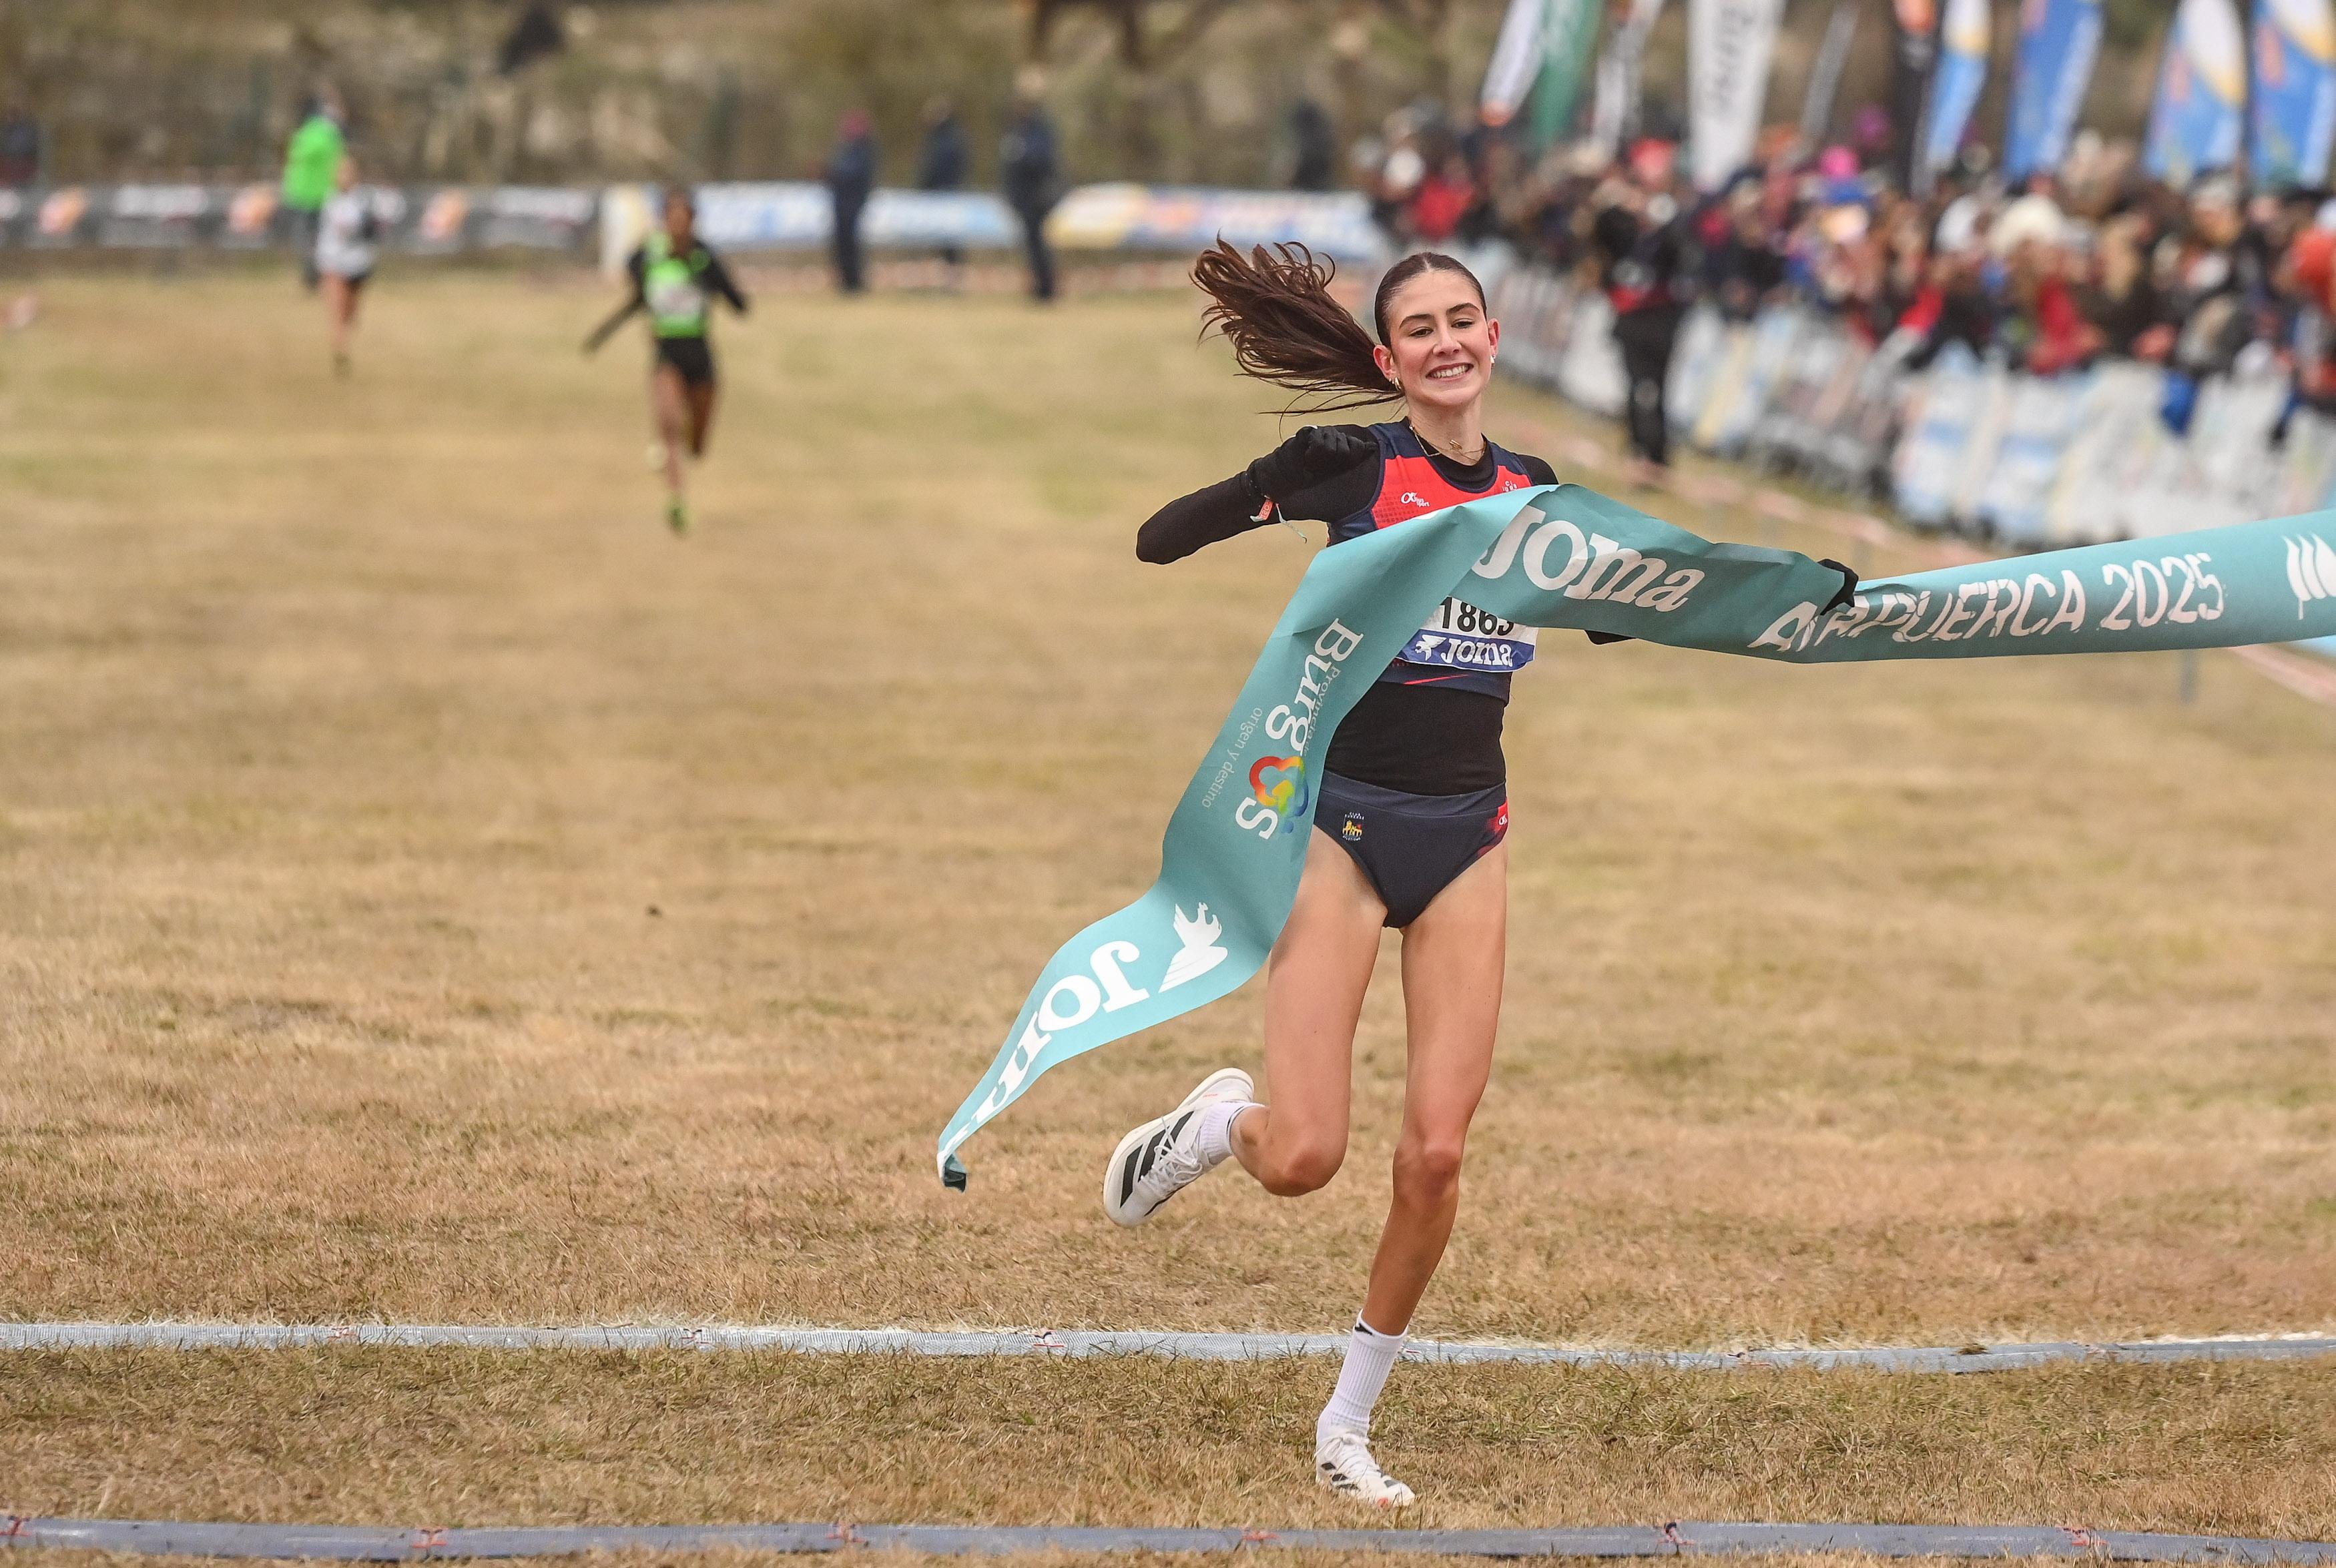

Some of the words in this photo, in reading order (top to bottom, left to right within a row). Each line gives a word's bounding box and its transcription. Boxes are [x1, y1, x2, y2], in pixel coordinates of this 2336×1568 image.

[2100, 552, 2224, 631] 2025
[1235, 707, 1263, 749] origen
[1307, 665, 1342, 739] Provincia
[1202, 761, 1235, 808] destino
[1227, 749, 1240, 761] y
[944, 940, 1150, 1153] Jom
